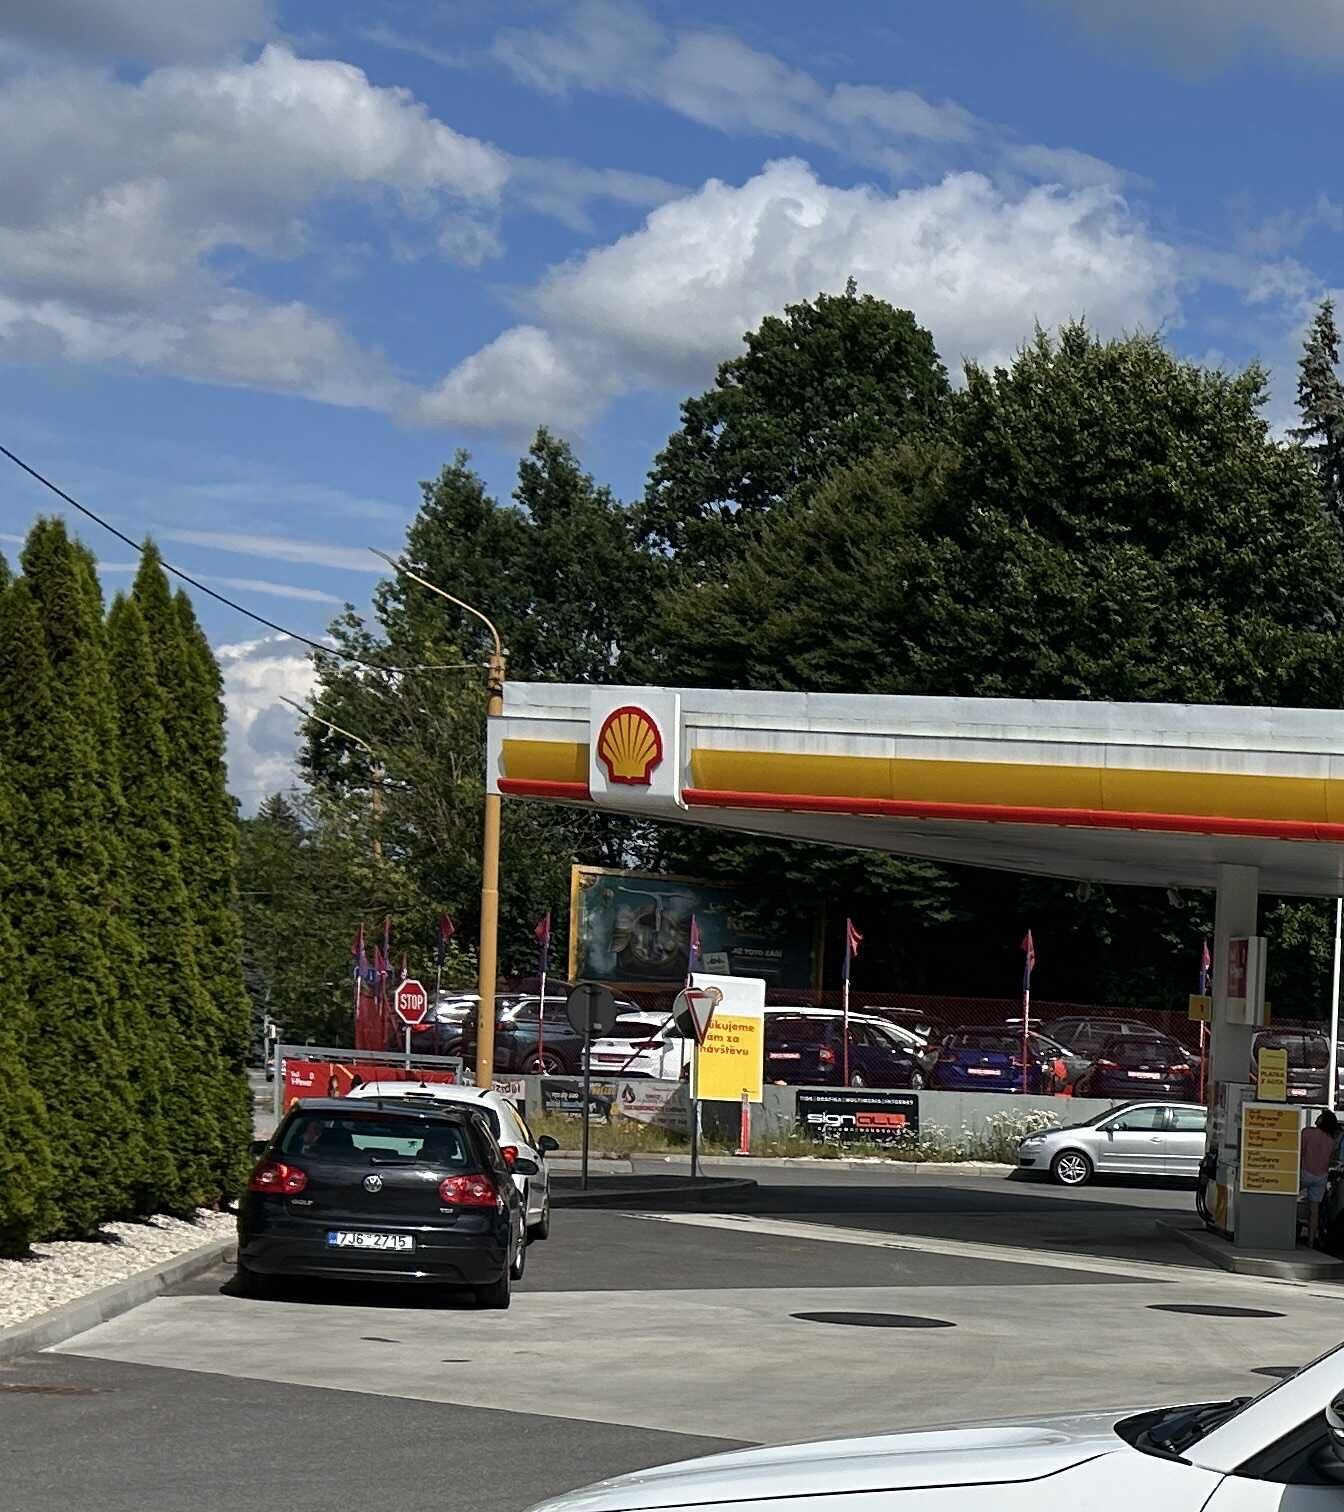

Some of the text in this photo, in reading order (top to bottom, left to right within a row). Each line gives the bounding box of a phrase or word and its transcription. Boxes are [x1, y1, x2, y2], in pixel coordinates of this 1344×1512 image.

[400, 994, 424, 1010] STOP
[708, 1019, 755, 1033] ěkujeme
[726, 1035, 740, 1043] za
[339, 1231, 406, 1248] 7J6 2715
